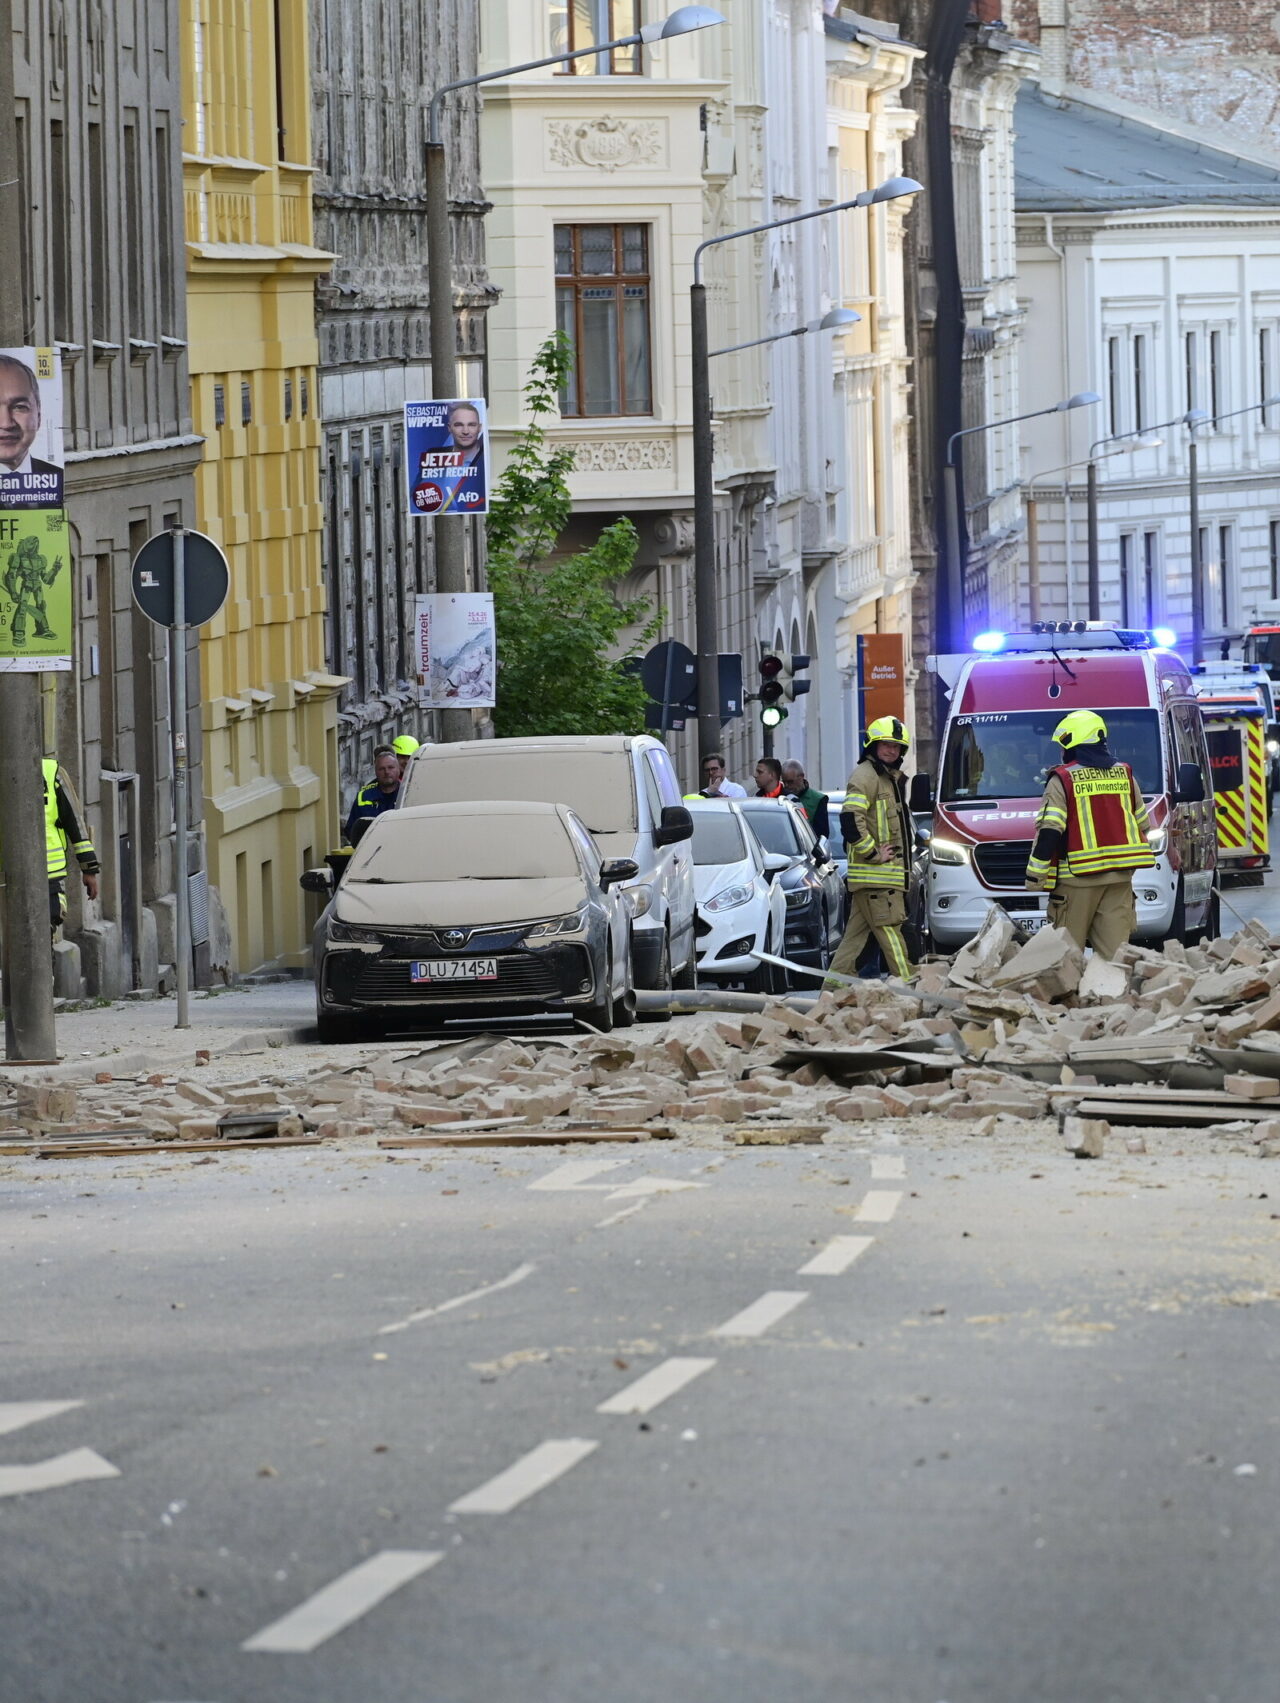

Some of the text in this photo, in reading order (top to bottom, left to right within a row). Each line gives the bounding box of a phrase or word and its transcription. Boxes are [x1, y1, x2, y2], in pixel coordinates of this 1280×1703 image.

[38, 359, 50, 368] 10.
[407, 405, 448, 416] SEBASTIAN
[407, 416, 445, 428] WIPPEL
[421, 452, 461, 467] JETZT
[421, 466, 478, 478] ERST RECHT!
[23, 473, 59, 489] URSU
[415, 498, 425, 507] OB
[458, 491, 480, 503] AfD
[418, 613, 430, 672] traumzeit
[957, 715, 1008, 726] GR 11/11/1
[1071, 767, 1127, 780] FEUERWEHR
[1095, 781, 1129, 792] Innenstadt
[418, 960, 495, 978] DLU 7145A
